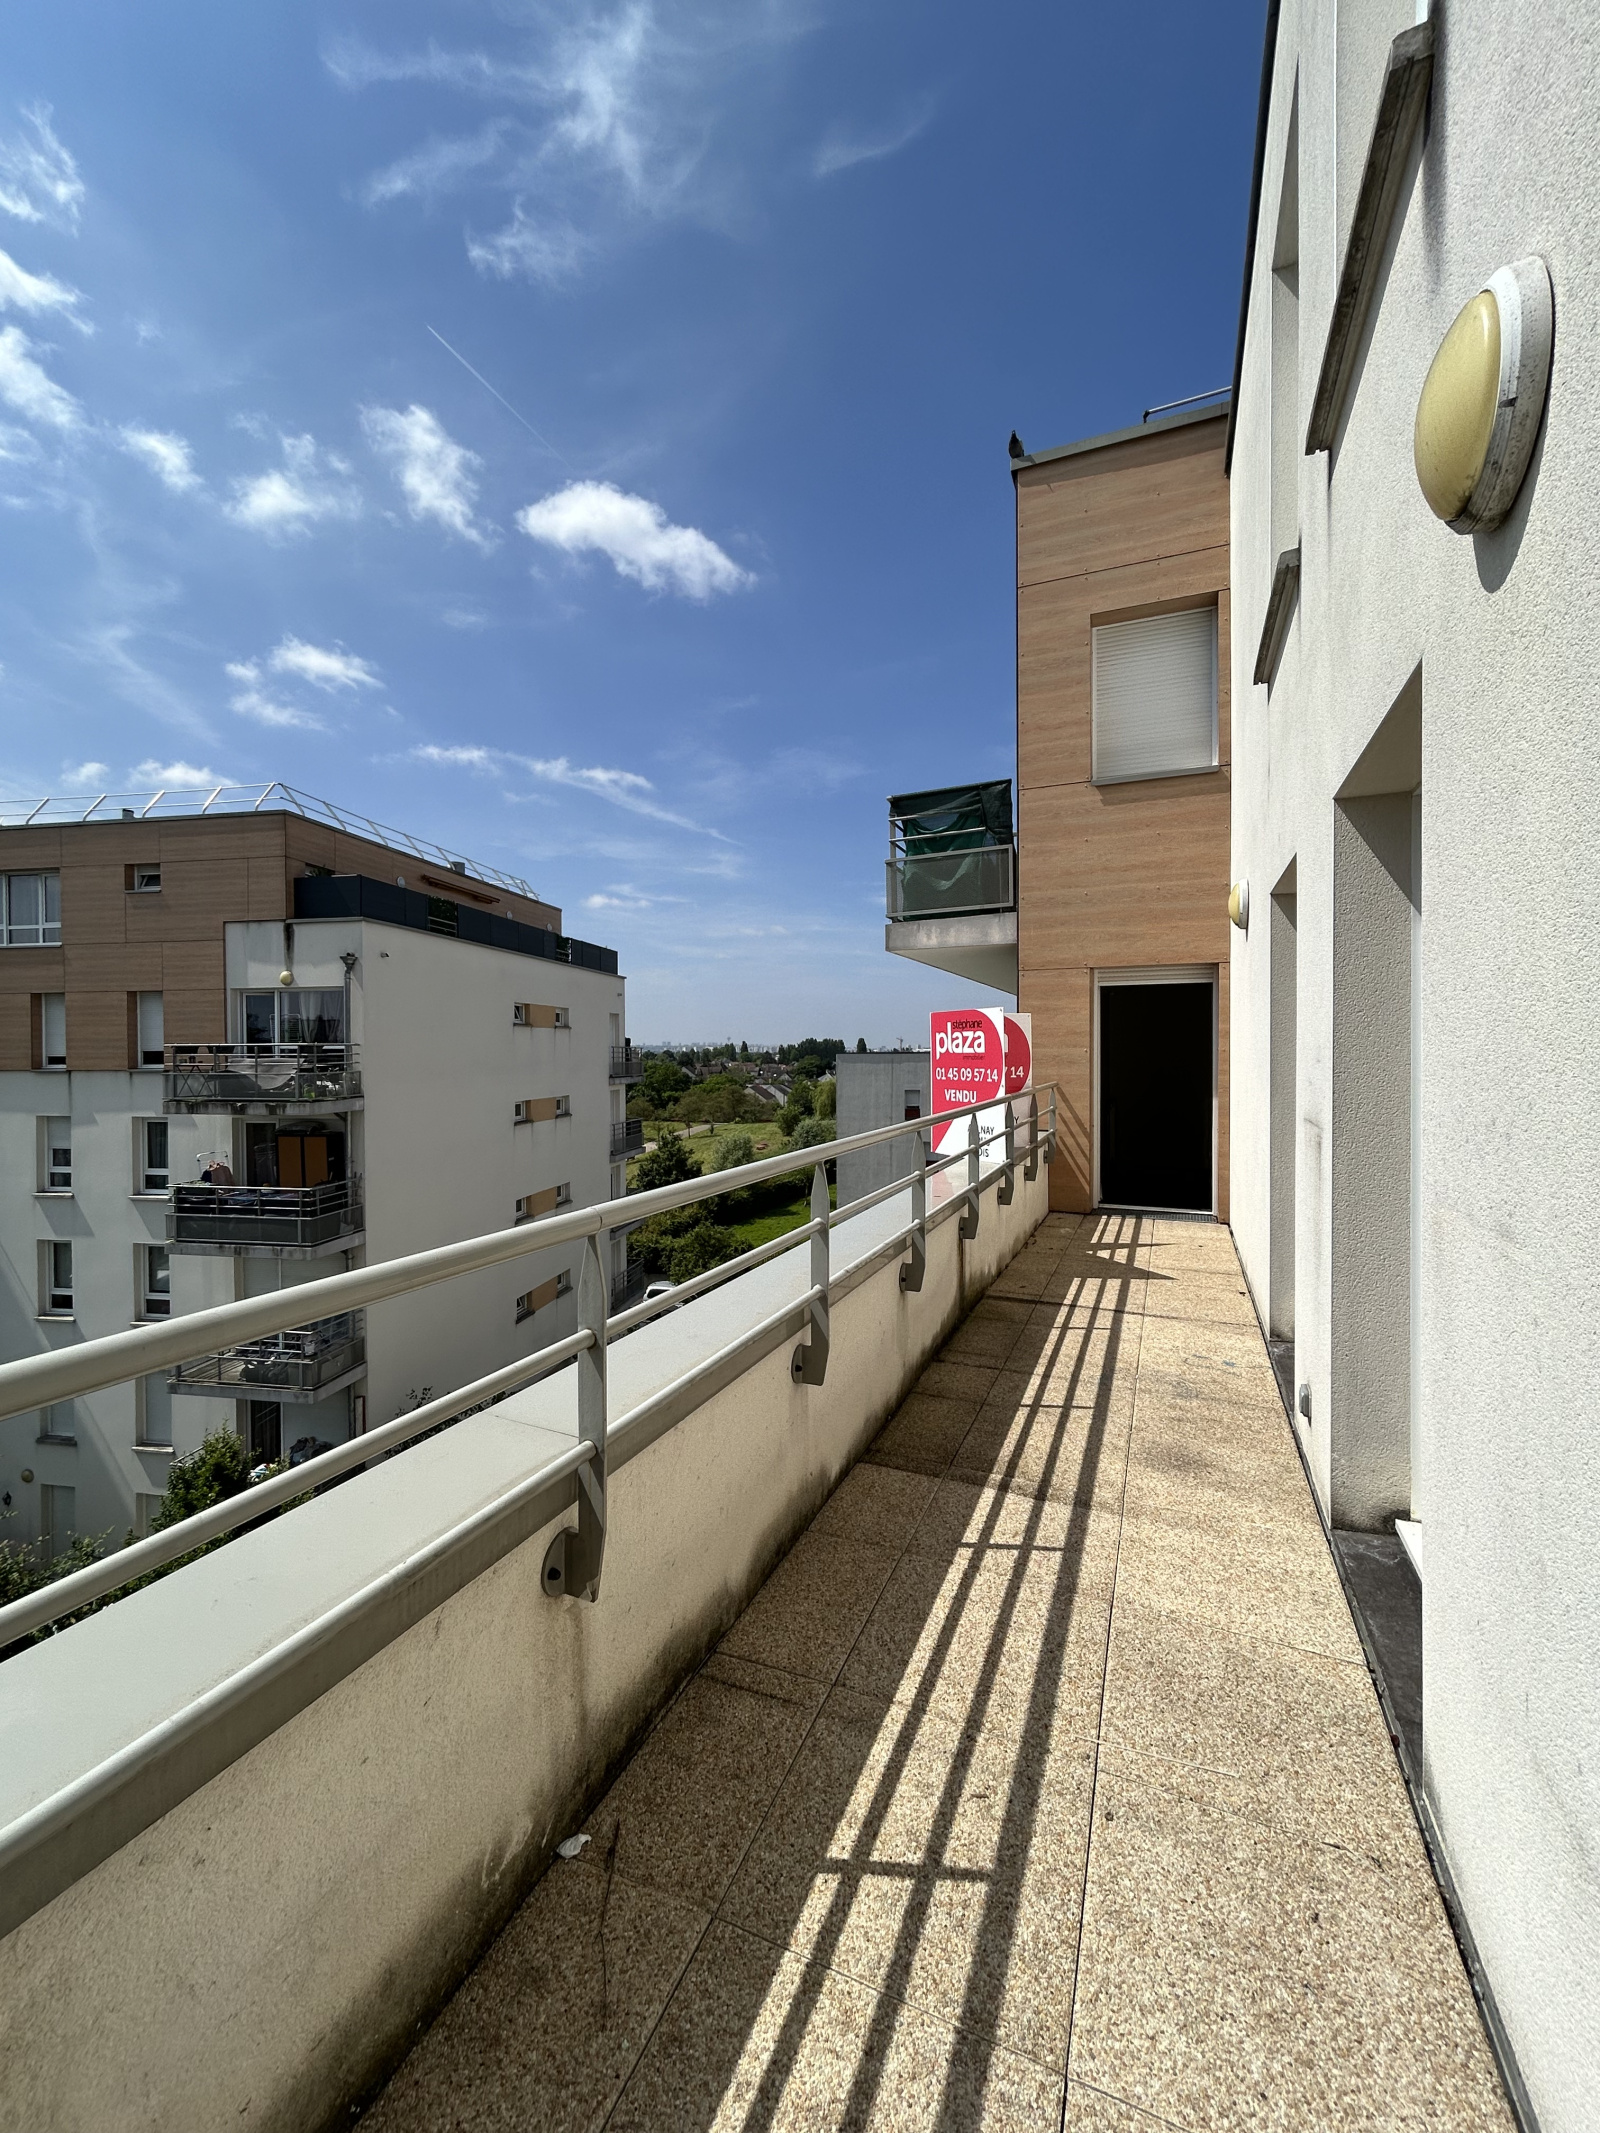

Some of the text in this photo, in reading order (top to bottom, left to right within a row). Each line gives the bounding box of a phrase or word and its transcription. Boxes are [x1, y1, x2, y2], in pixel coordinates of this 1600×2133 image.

[935, 1021, 985, 1060] plaza
[935, 1067, 946, 1080] 01
[947, 1067, 958, 1080] 45
[960, 1068, 972, 1081] 09
[974, 1068, 985, 1081] 57
[986, 1068, 998, 1082] 14
[1010, 1066, 1024, 1078] 14
[944, 1088, 977, 1103] VENDU
